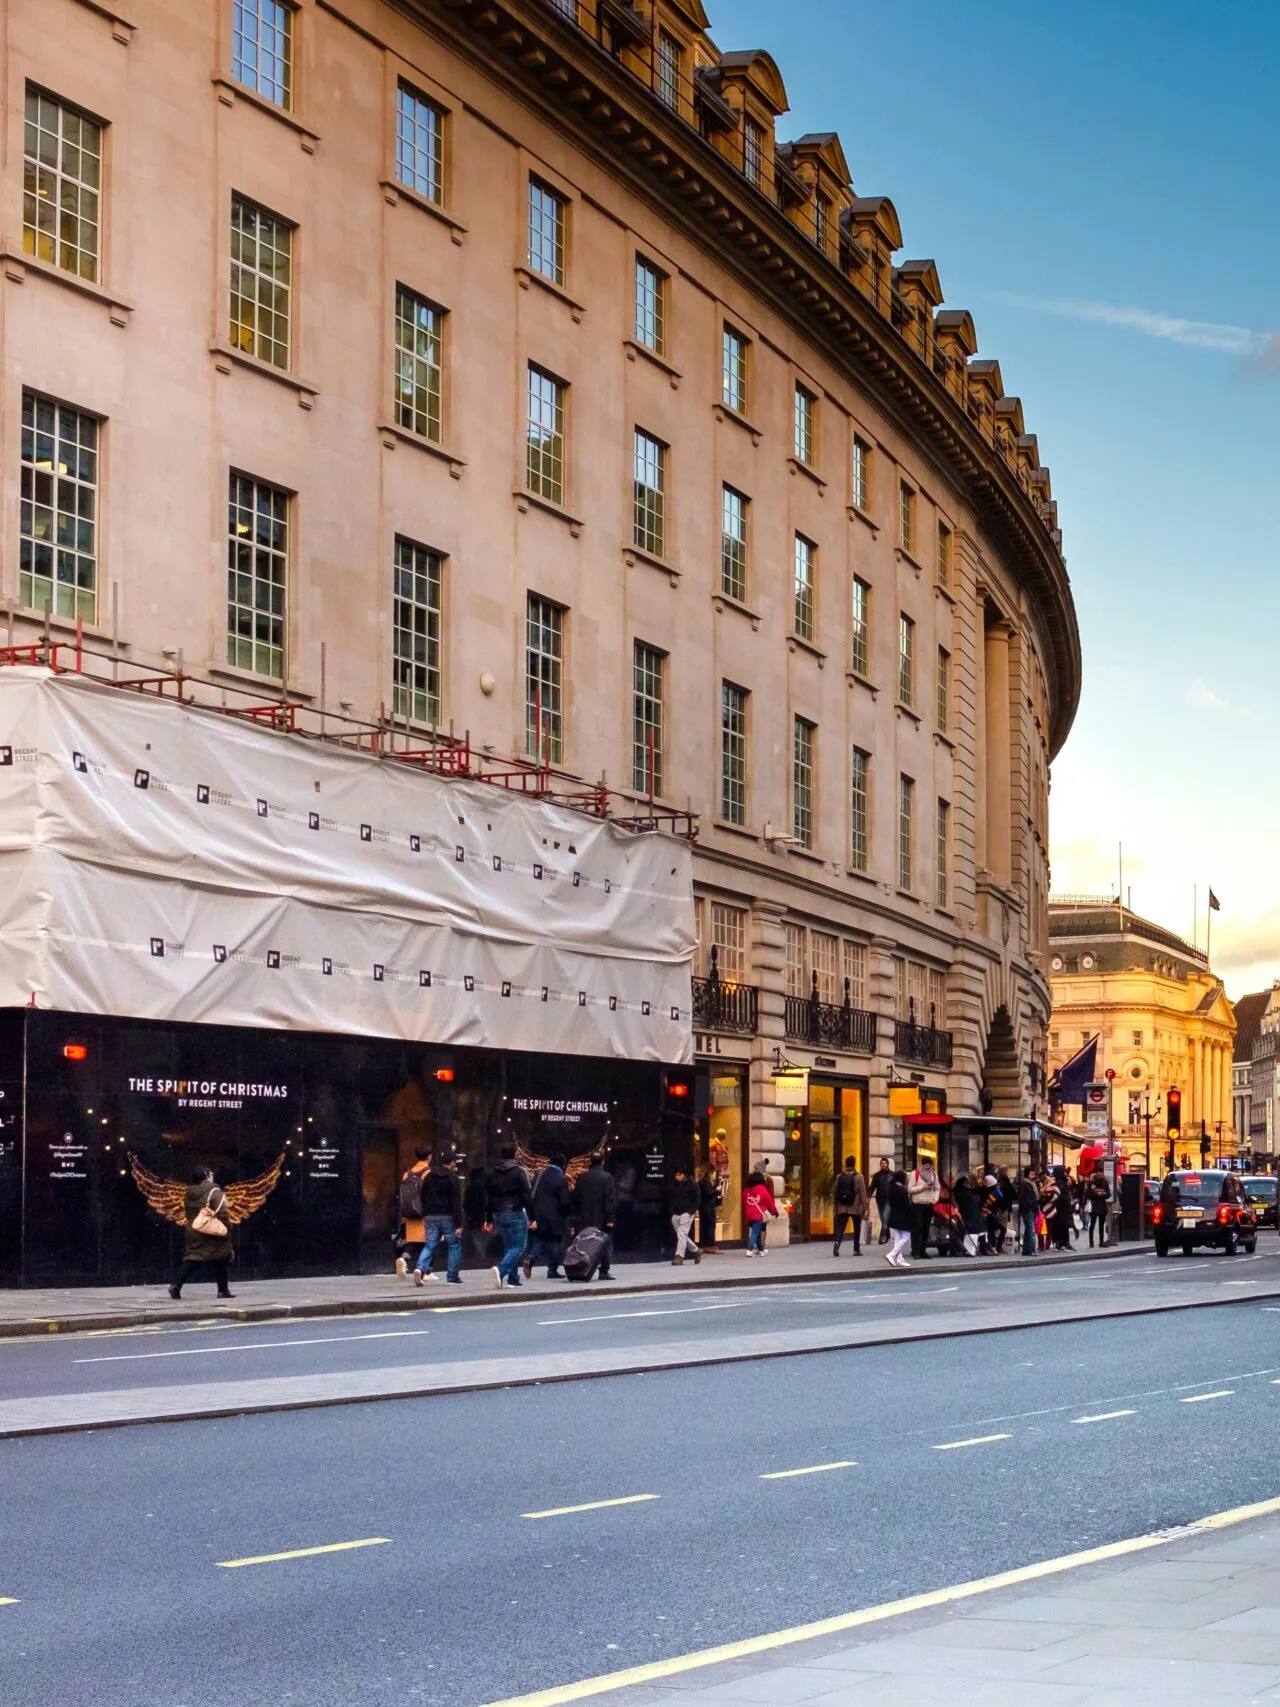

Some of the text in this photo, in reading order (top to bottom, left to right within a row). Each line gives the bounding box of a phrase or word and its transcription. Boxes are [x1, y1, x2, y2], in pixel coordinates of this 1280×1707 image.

[1107, 1070, 1114, 1078] F
[128, 1077, 153, 1092] THE
[200, 1081, 217, 1095] OF
[219, 1083, 288, 1098] CHRISTMAS
[178, 1098, 243, 1109] BY REGENT STREET
[513, 1098, 528, 1110] THE
[554, 1100, 565, 1111] OF
[566, 1101, 608, 1113] CHRISTMAS
[548, 1114, 564, 1122] REGENT
